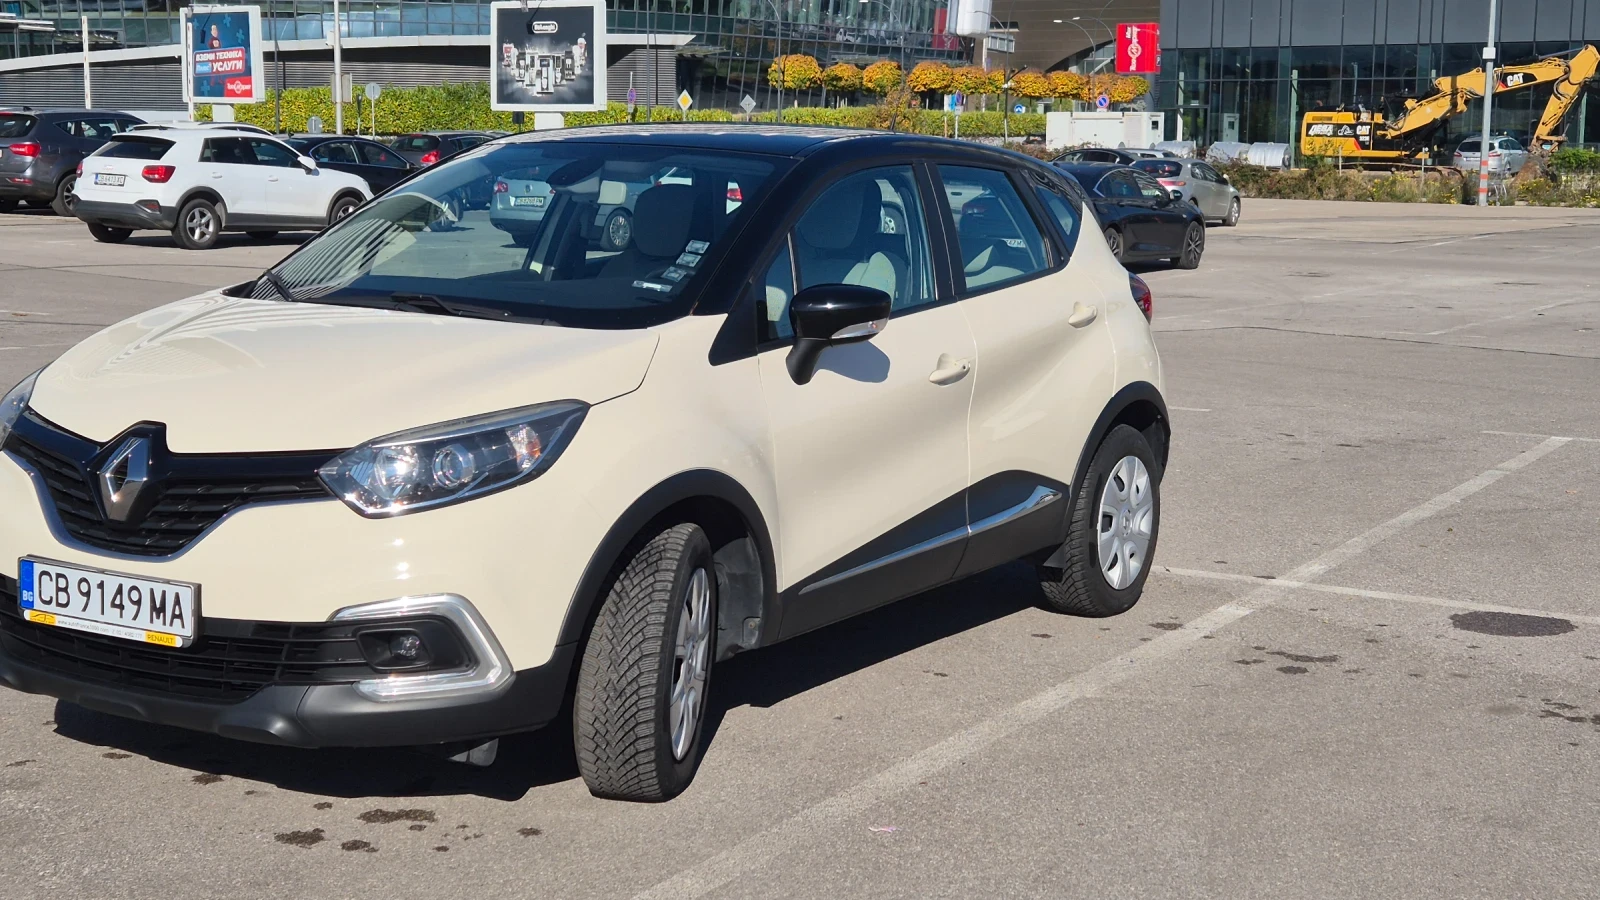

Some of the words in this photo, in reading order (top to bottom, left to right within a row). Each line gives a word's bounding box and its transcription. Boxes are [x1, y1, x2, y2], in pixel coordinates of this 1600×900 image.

[195, 53, 215, 62] ВЗЕМИ
[216, 50, 242, 60] ТЕХНИКА
[212, 60, 242, 72] УСЛУГИ
[1506, 72, 1524, 86] CAT
[1356, 125, 1371, 135] CAT
[22, 590, 34, 602] BG
[37, 570, 71, 609] CB
[77, 577, 143, 621] 9149
[149, 587, 186, 629] MA
[146, 633, 175, 645] RENAULT
